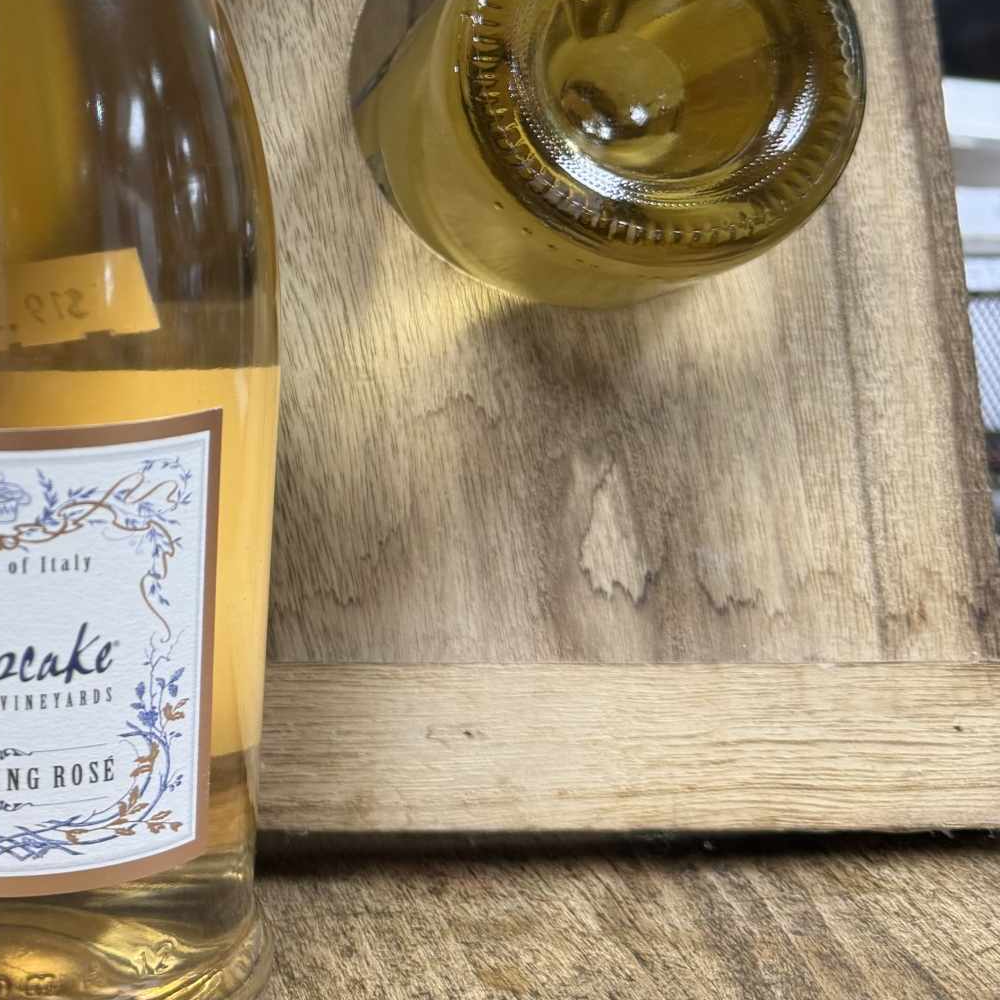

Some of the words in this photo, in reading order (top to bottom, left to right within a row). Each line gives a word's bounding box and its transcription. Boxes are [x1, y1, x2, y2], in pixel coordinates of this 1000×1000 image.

[8, 554, 28, 575] of
[39, 554, 92, 575] Italy
[0, 686, 114, 712] VINEYARDS
[52, 755, 116, 789] ROSÉ
